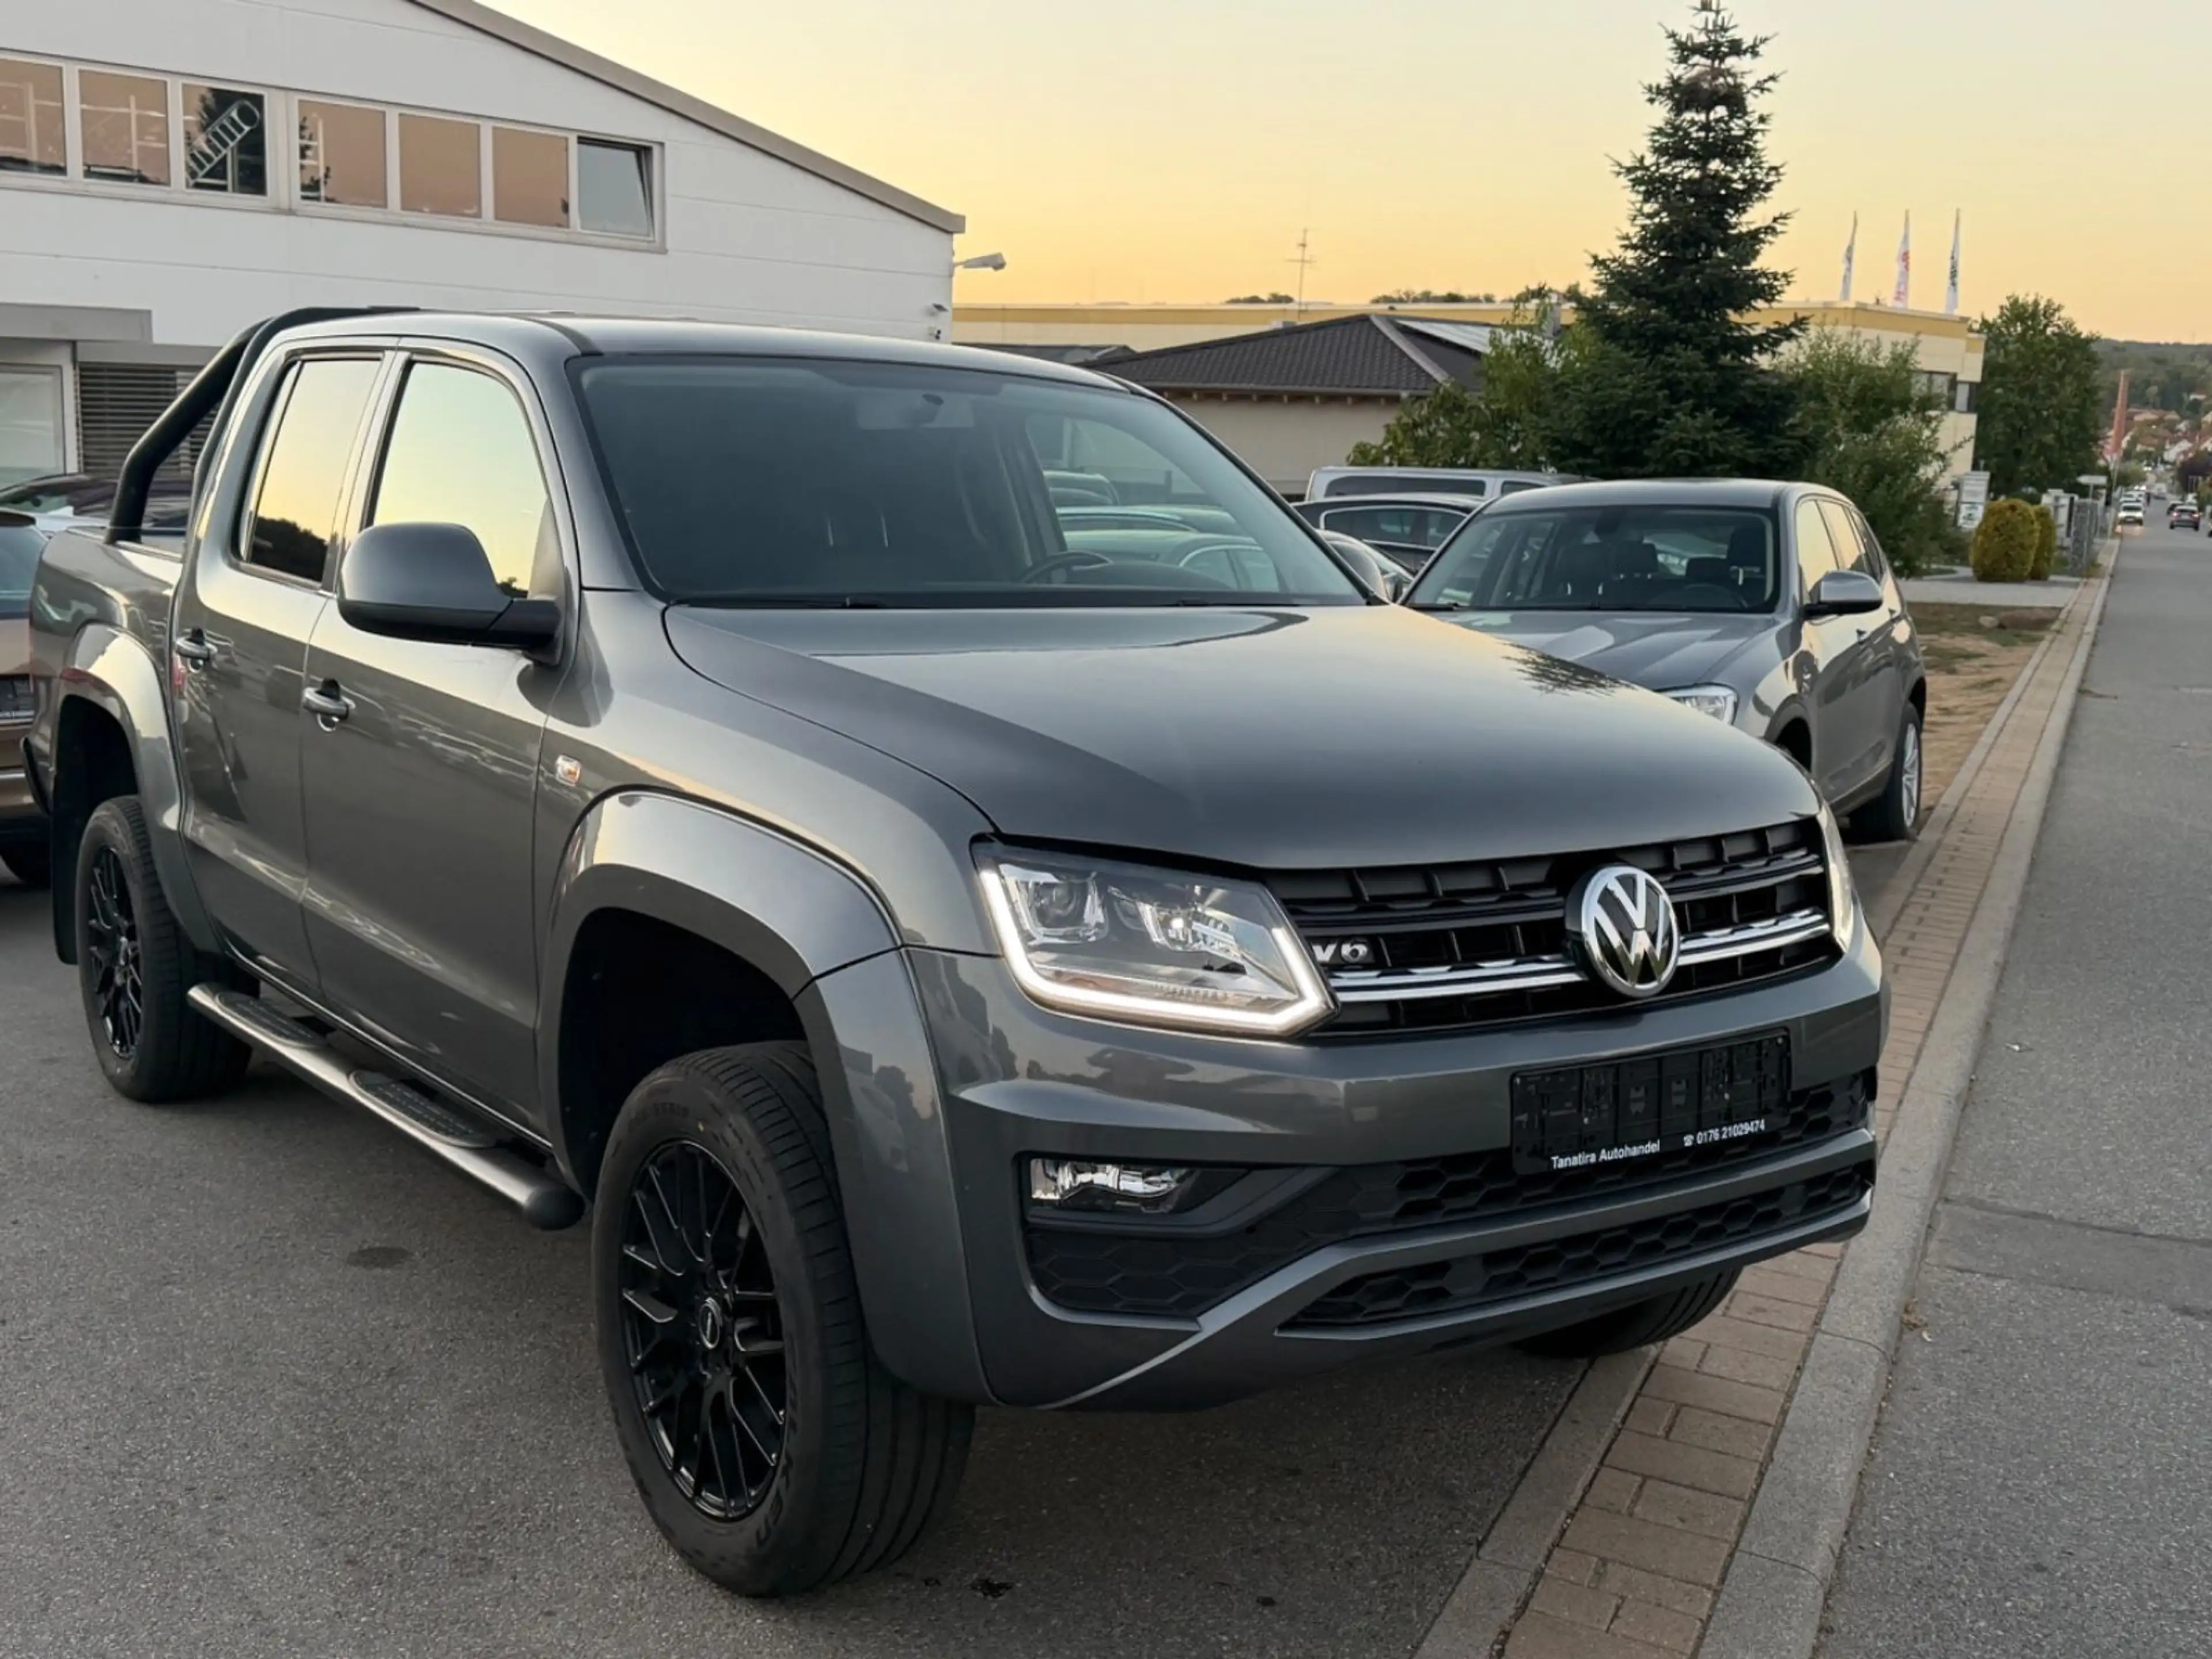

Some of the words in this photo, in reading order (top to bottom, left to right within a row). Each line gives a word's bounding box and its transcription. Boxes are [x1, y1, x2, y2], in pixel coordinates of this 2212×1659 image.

[1582, 866, 1679, 997] VW
[1312, 938, 1369, 963] V6
[1696, 1127, 1720, 1145] 0176
[1550, 1151, 1597, 1169] Tanatira
[1599, 1138, 1660, 1162] Autohandel
